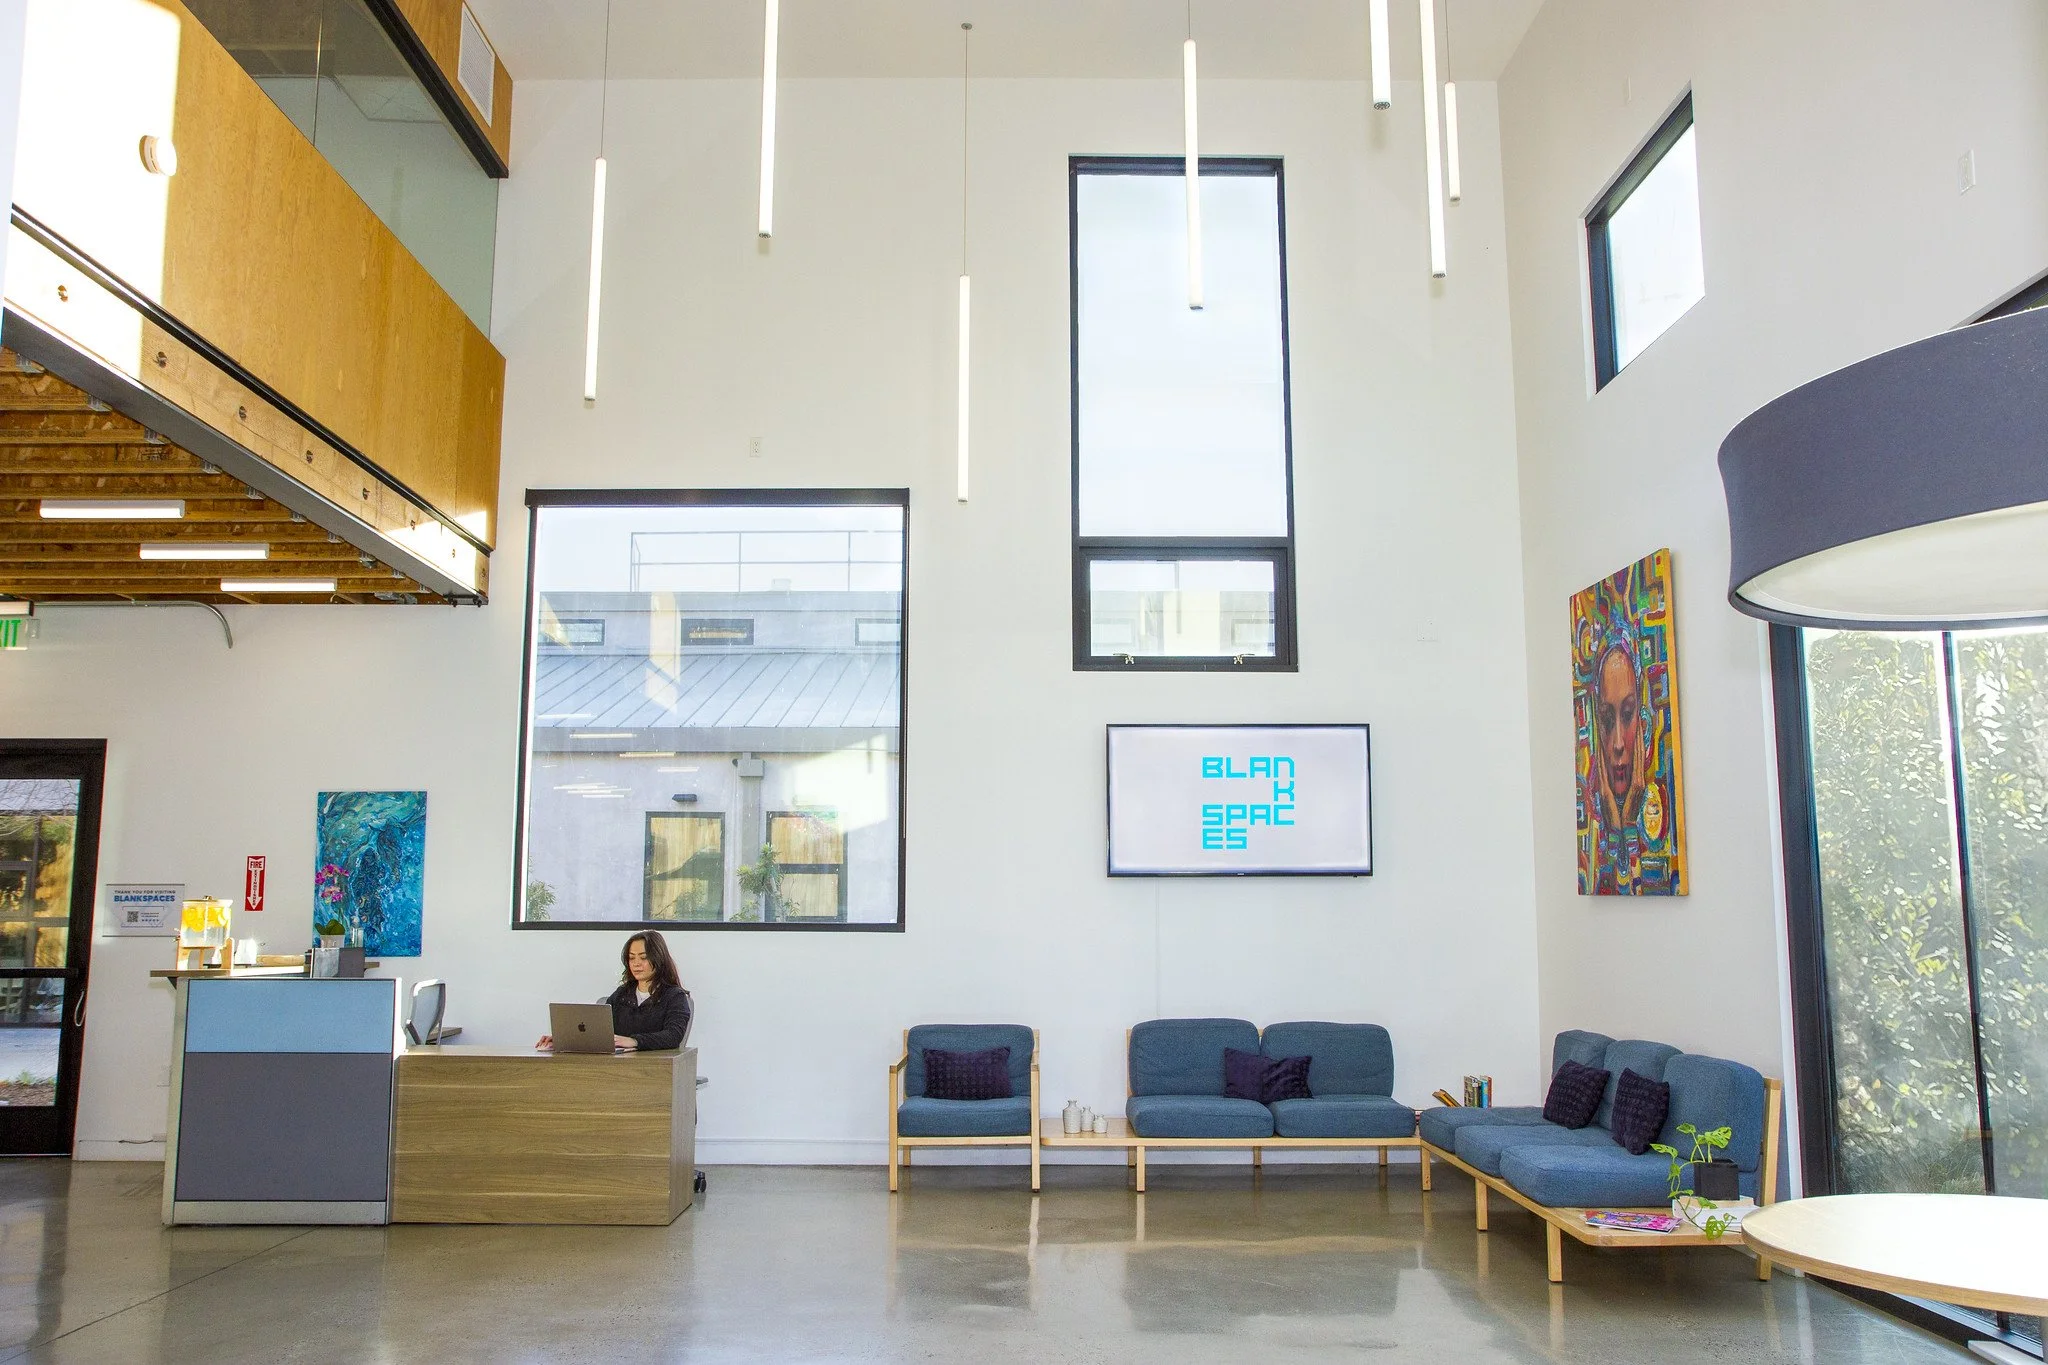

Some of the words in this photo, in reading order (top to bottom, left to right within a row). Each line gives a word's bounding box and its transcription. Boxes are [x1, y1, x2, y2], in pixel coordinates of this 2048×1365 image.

[1202, 757, 1295, 778] BLAN
[1273, 781, 1295, 802] K
[1202, 804, 1295, 826] SPAC
[1202, 828, 1247, 849] ES
